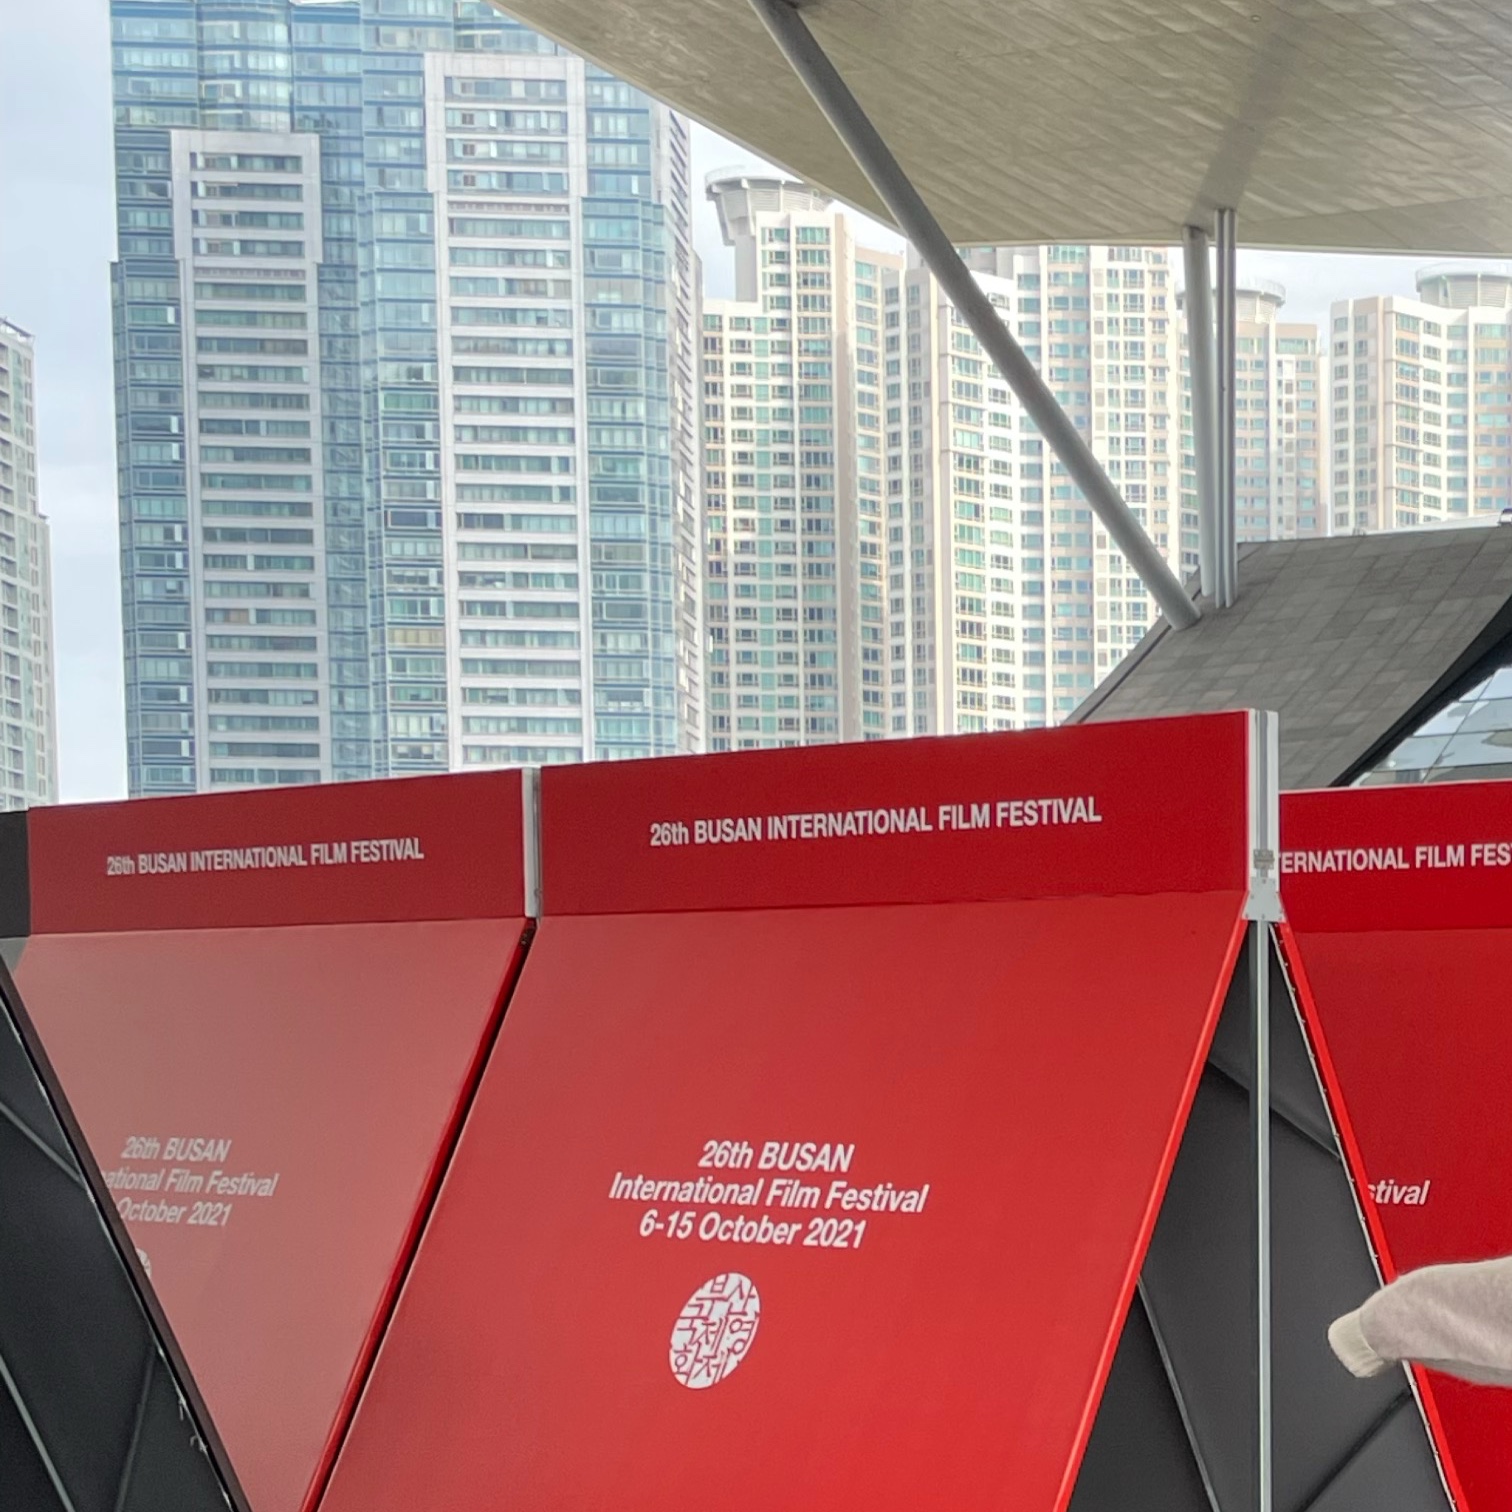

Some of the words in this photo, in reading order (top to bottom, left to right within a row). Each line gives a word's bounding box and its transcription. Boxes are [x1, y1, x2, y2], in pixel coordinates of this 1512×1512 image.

[650, 822, 689, 847] 26th
[694, 817, 761, 844] BUSAN
[767, 806, 932, 840] INTERNATIONAL
[938, 803, 990, 831] FILM
[996, 796, 1101, 827] FESTIVAL
[107, 855, 135, 875] 26th
[139, 852, 188, 874] BUSAN
[191, 845, 307, 871] INTERNATIONAL
[310, 842, 347, 864] FILM
[350, 837, 424, 862] FESTIVAL
[1279, 847, 1409, 873] ERNATIONAL
[1415, 845, 1464, 868] FILM
[121, 1136, 161, 1160] 26th
[163, 1138, 231, 1162] BUSAN
[698, 1140, 754, 1169] 26th
[758, 1141, 855, 1173] BUSAN
[165, 1168, 204, 1193] Film
[205, 1170, 279, 1197] Festival
[608, 1171, 764, 1206] International
[765, 1178, 821, 1210] Film
[824, 1180, 930, 1213] Festival
[187, 1201, 232, 1227] 2021
[639, 1209, 696, 1239] 6-15
[699, 1211, 802, 1246] October
[803, 1217, 867, 1249] 2021
